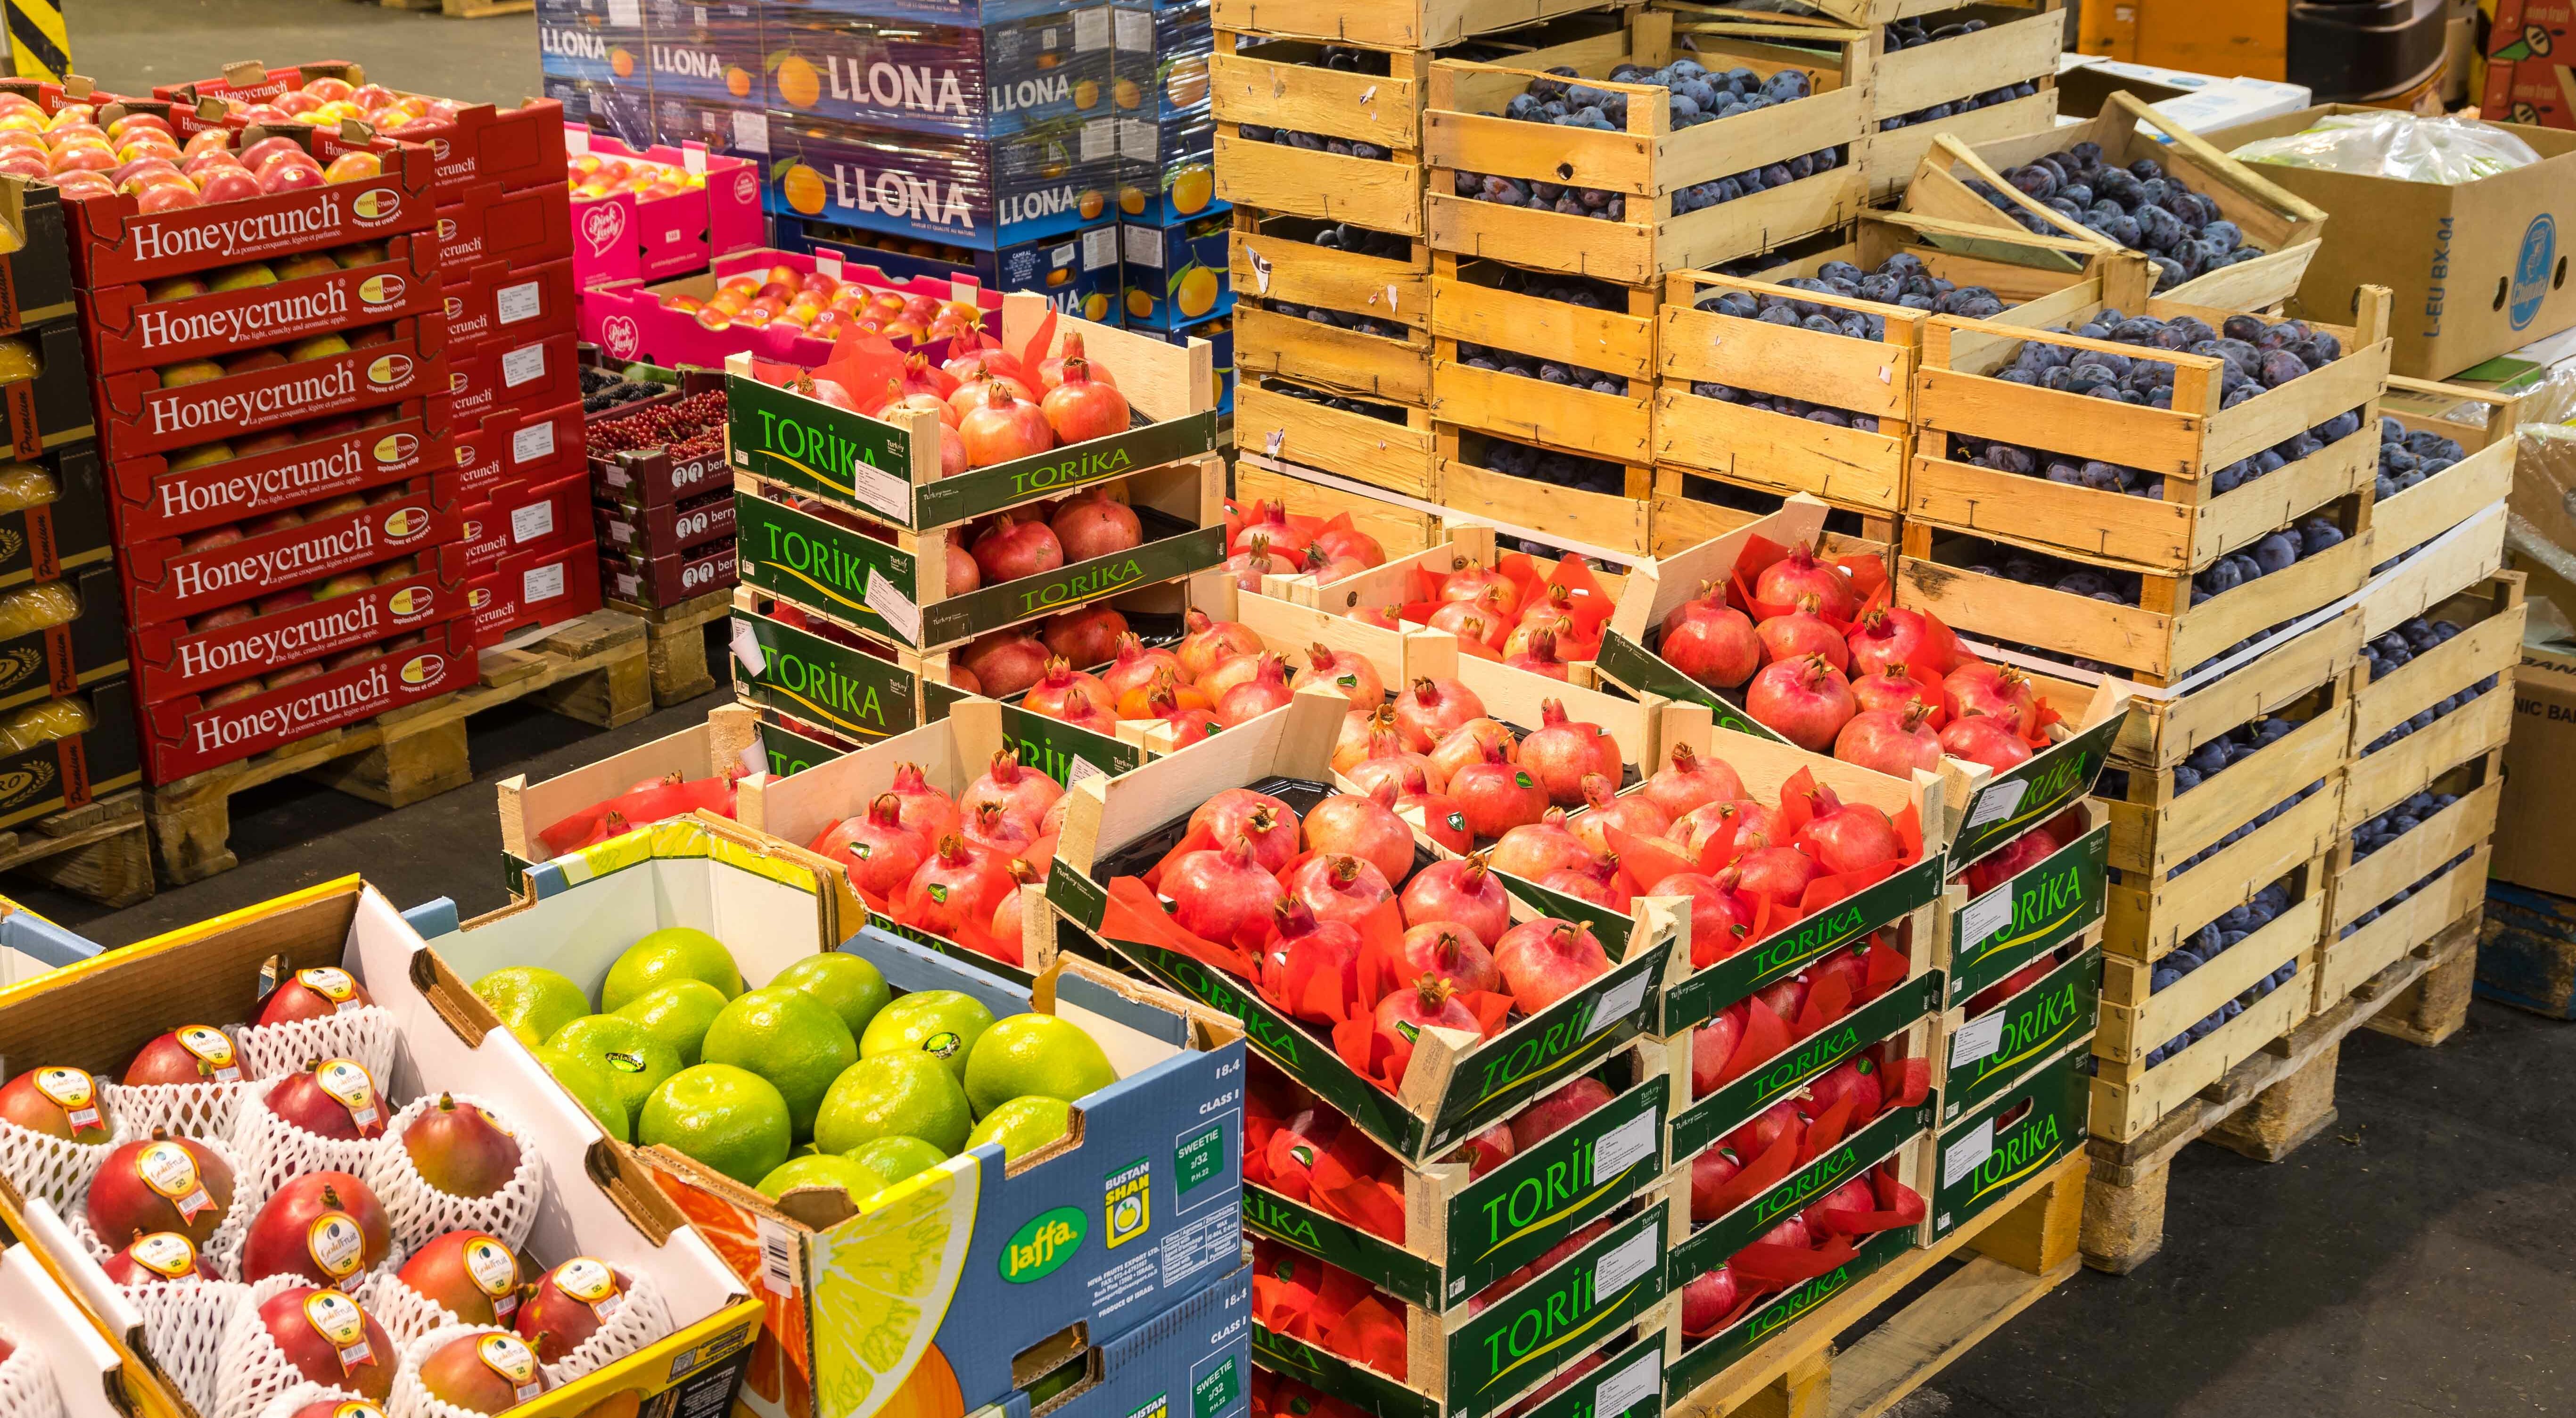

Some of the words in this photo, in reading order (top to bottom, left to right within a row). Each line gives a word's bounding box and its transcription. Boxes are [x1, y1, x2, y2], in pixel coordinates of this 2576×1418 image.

[542, 27, 606, 59] LLONA
[652, 45, 721, 78] LLONA
[827, 56, 968, 117] LLONA
[991, 74, 1069, 113] LLONA
[437, 157, 475, 176] crunch
[357, 199, 376, 207] Honey
[377, 198, 397, 207] Crunch
[834, 165, 974, 229] LLONA
[999, 185, 1074, 226] LLONA
[131, 194, 341, 262] Honeycrunch
[589, 207, 616, 233] Pink
[595, 220, 619, 243] Lady
[440, 237, 481, 260] ycrunch
[2431, 217, 2454, 280] BX-04
[364, 284, 382, 293] Honey
[383, 283, 403, 293] Crunch
[139, 281, 348, 348] Honeycrunch
[363, 304, 393, 314] explosively
[394, 298, 406, 310] crisp
[2422, 287, 2445, 337] L-EU
[449, 314, 487, 335] crunch
[609, 322, 630, 340] Pink
[612, 333, 634, 352] Lady
[371, 365, 390, 373] Honey
[390, 363, 410, 373] Crunch
[150, 362, 356, 435] Honeycrunch
[453, 388, 492, 409] crunch
[19, 391, 33, 455] Premium
[378, 444, 396, 453] Honey
[397, 442, 417, 452] Crunch
[887, 440, 905, 453] Turkey
[377, 462, 406, 473] explosively
[407, 456, 419, 466] crisp
[461, 460, 499, 481] crunch
[159, 443, 363, 519] Honeycrunch
[923, 491, 942, 501] Turkey
[388, 519, 405, 527] Honey
[407, 515, 426, 526] Crunch
[39, 514, 52, 579] Premium
[173, 518, 373, 599] Honeycrunch
[466, 534, 506, 559] ycrunch
[764, 522, 878, 596] TORİK
[394, 596, 411, 606] Honey
[412, 594, 431, 604] Crunch
[476, 601, 514, 625] crunch
[178, 597, 379, 678] Honeycrunch
[57, 633, 70, 693] Premium
[404, 665, 421, 674] Honey
[422, 662, 441, 673] Crunch
[890, 679, 908, 691] Turkey
[192, 667, 389, 754] Honeycrunch
[72, 745, 84, 804] Premium
[1113, 756, 1134, 770] Turkey
[1056, 866, 1077, 887] Turkey
[1479, 1002, 1597, 1100] TORİK
[1216, 1059, 1240, 1079] 18.4
[1199, 1093, 1232, 1115] CLASS
[1641, 1087, 1660, 1100] Turkey
[1676, 1117, 1694, 1130] Turkey
[1178, 1129, 1218, 1159] SWEETIE
[1191, 1153, 1208, 1170] 2/32
[1105, 1162, 1149, 1191] BUSTAN
[1191, 1168, 1209, 1182] P.H.22
[1105, 1174, 1149, 1206] SHAN
[1482, 1138, 1596, 1245] TORİK
[1642, 1211, 1661, 1225] Turkey
[1010, 1220, 1070, 1277] Jaffa
[1103, 1265, 1123, 1279] FRUITS
[1125, 1252, 1146, 1268] EXPORT
[1136, 1263, 1154, 1276] ISRAEL
[1099, 1300, 1125, 1318] PRODUCE
[1135, 1285, 1154, 1299] ISRAEL
[1226, 1288, 1247, 1309] 18.4
[1210, 1323, 1240, 1344] CLASS
[1484, 1267, 1596, 1376] TORİK
[1196, 1359, 1232, 1395] SWEETIE
